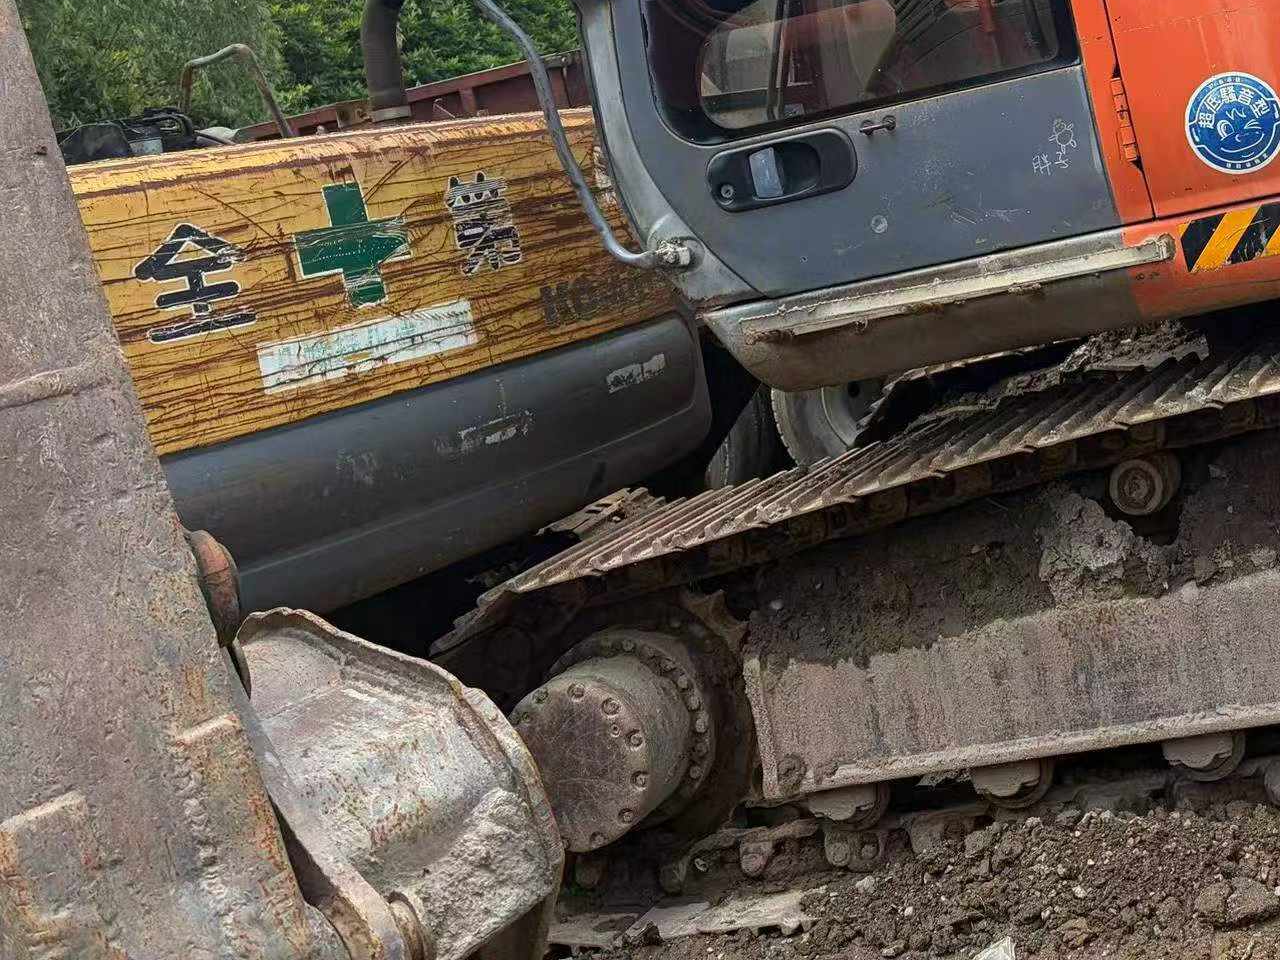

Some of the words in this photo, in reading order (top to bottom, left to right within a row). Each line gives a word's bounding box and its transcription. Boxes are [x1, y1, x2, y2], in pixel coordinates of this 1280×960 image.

[1197, 85, 1271, 130] 超低騒音型
